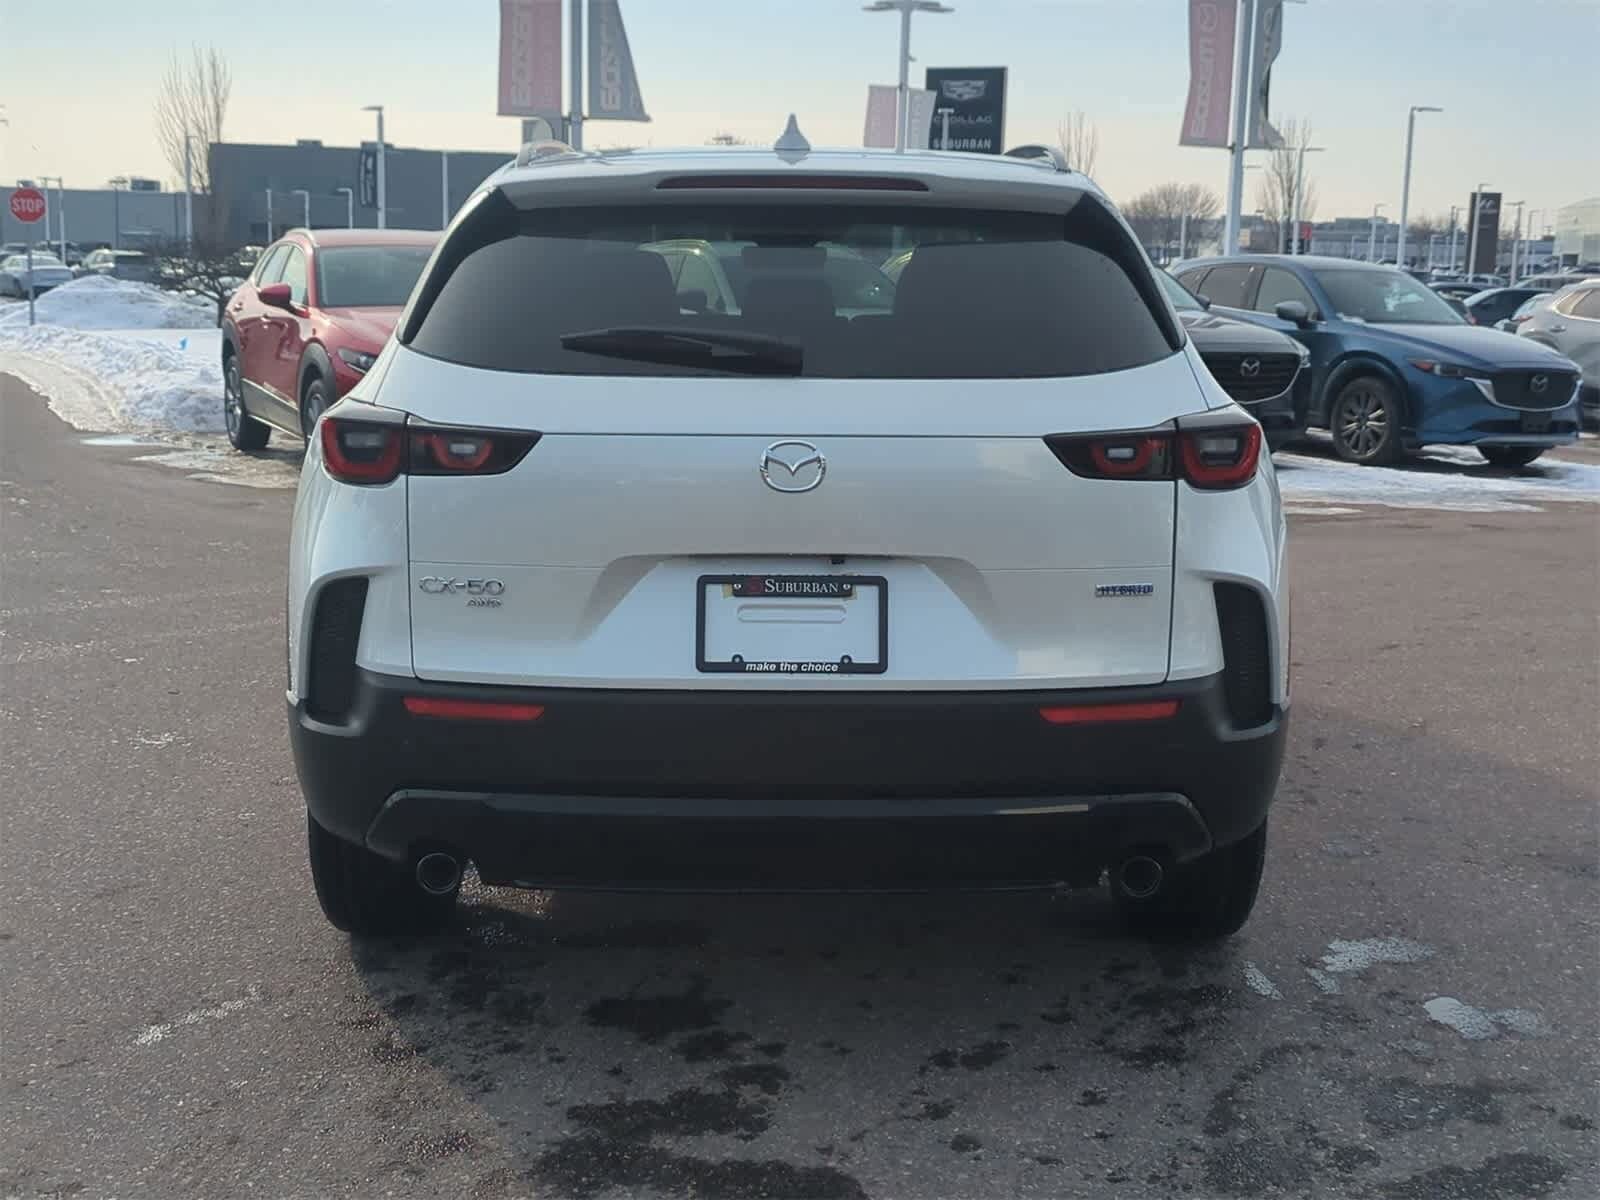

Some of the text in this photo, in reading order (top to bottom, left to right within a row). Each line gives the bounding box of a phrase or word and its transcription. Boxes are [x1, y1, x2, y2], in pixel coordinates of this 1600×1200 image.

[933, 115, 992, 125] CDILLAC
[933, 138, 991, 150] SBURBAN
[12, 198, 44, 213] STOP
[419, 576, 505, 596] CX-50
[764, 578, 839, 593] SUBURBAN
[1096, 583, 1153, 598] HYBRID
[466, 597, 503, 608] AWD
[745, 662, 839, 672] make the choice
